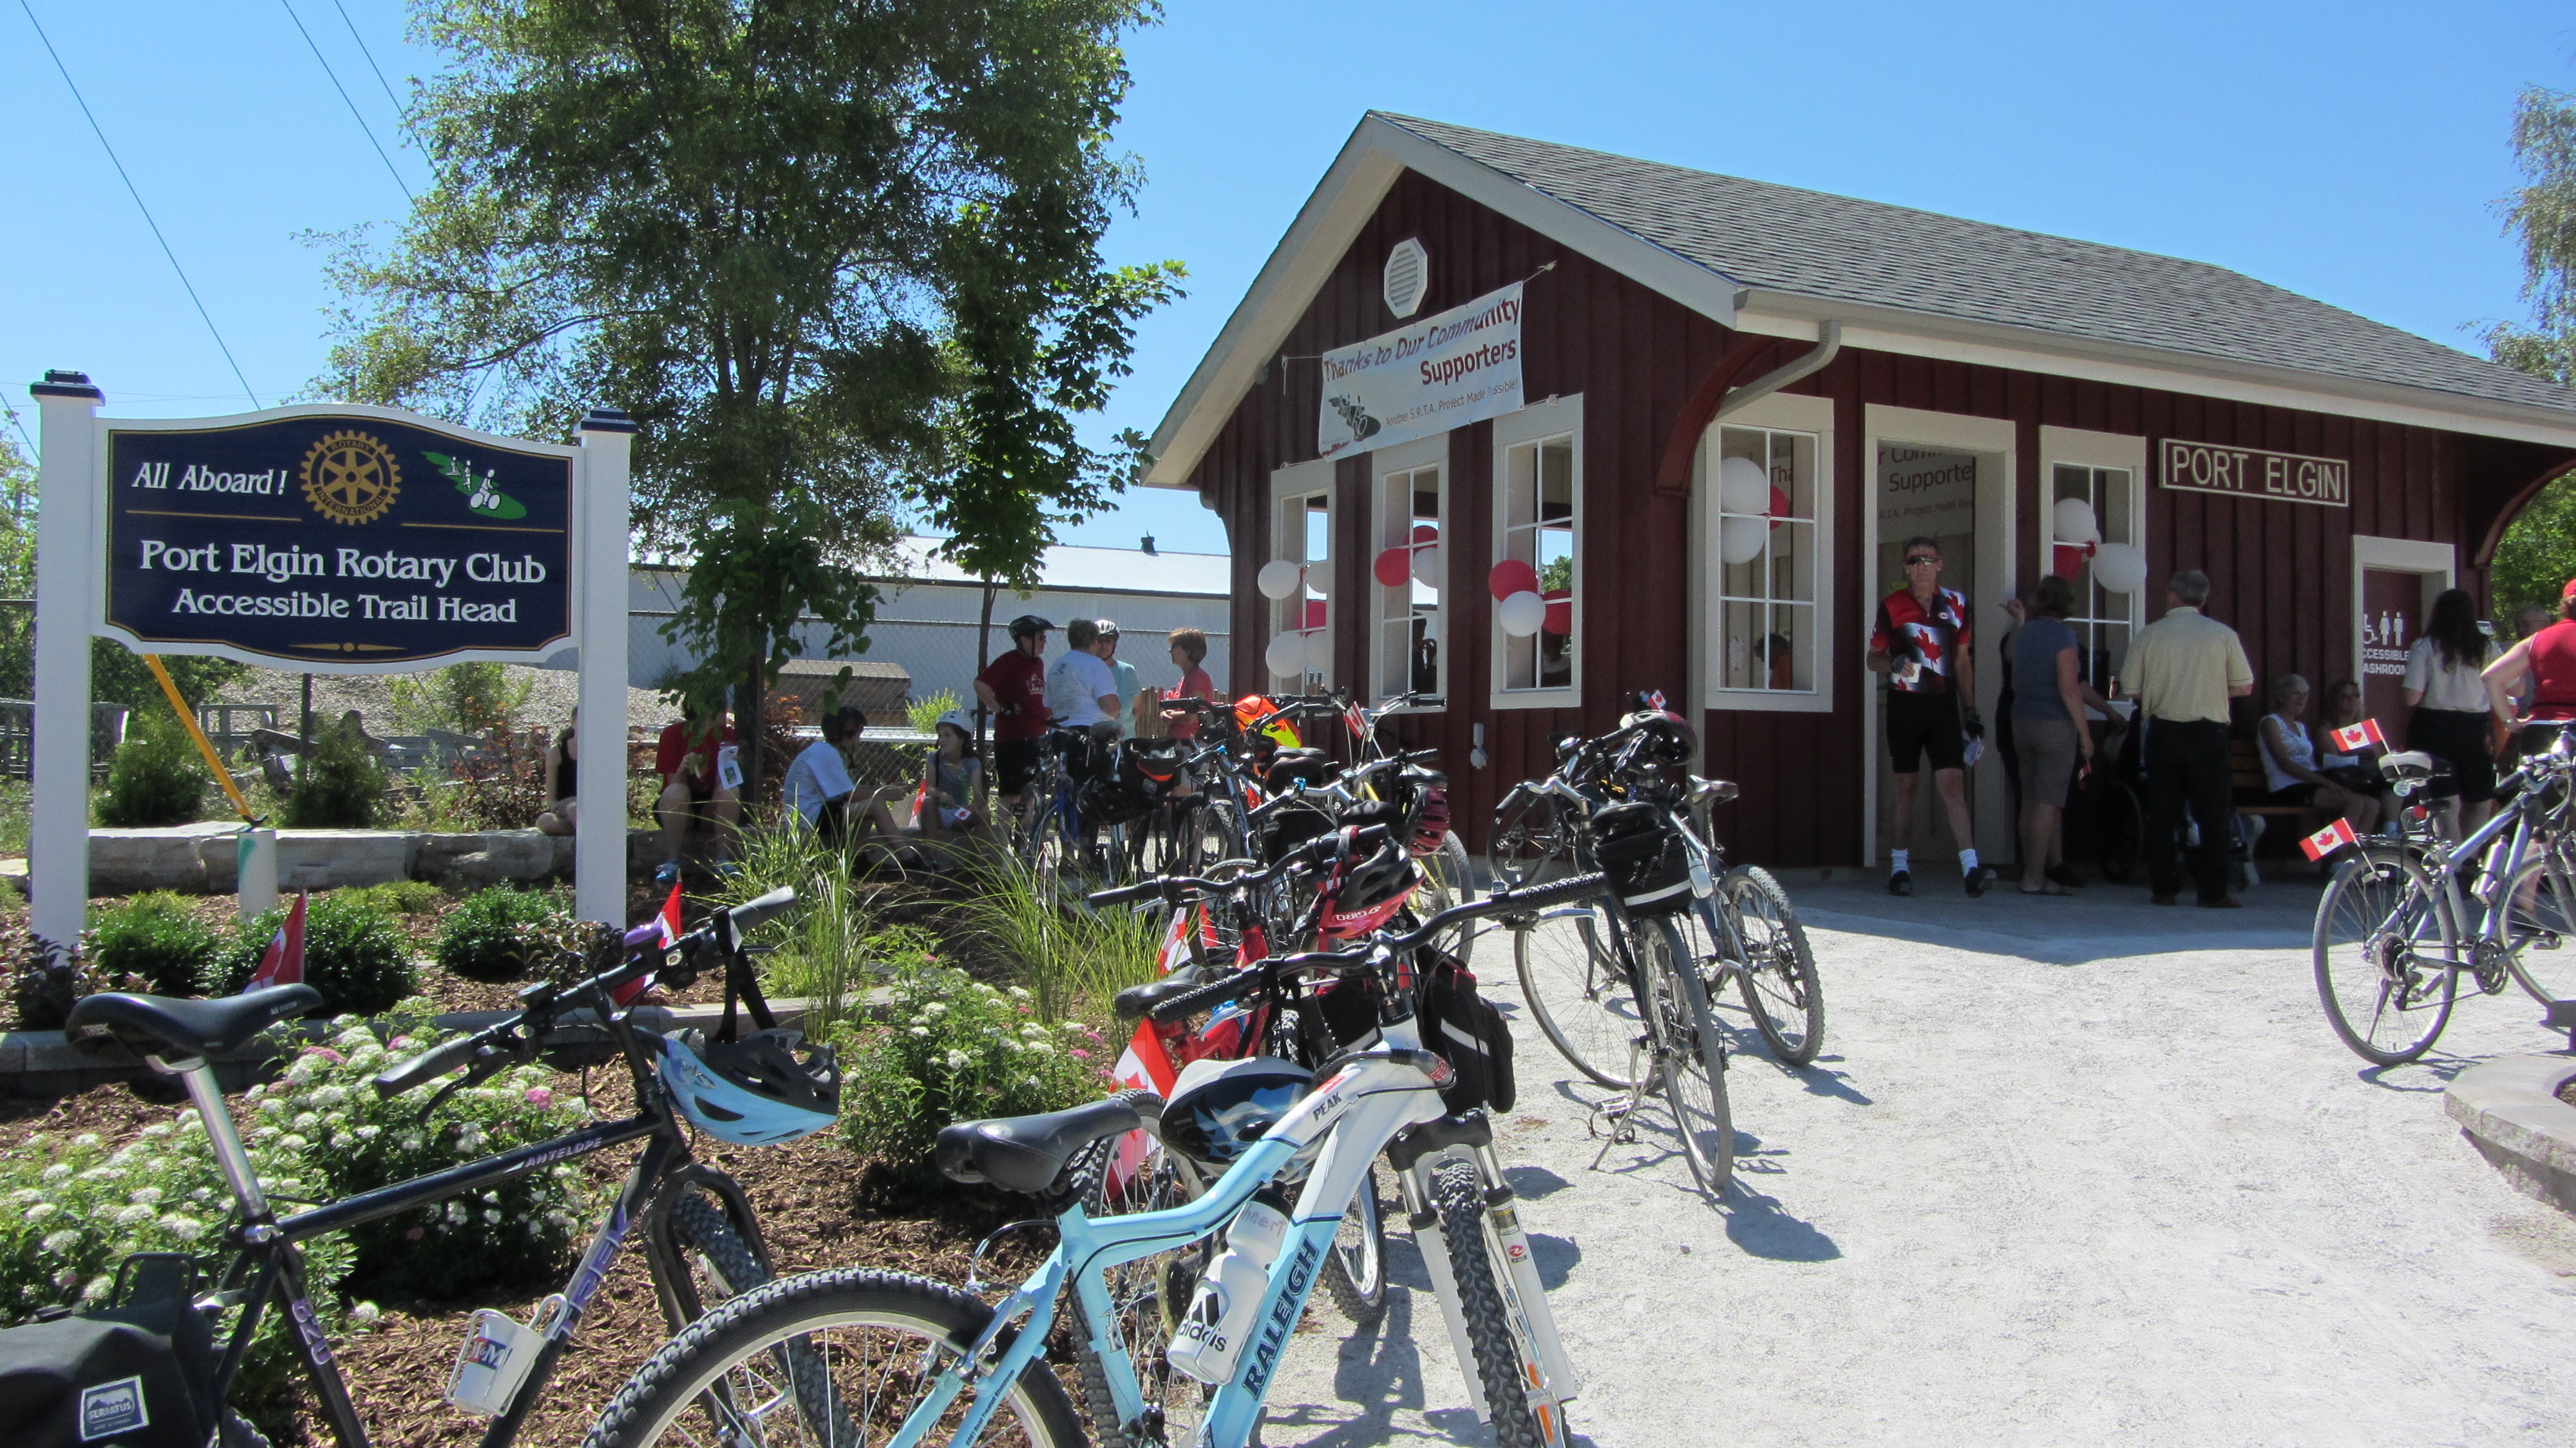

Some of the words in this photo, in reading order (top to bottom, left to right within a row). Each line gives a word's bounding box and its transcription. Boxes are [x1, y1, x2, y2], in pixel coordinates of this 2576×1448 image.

[1323, 350, 1372, 382] Thanks
[1374, 347, 1392, 366] to
[1395, 336, 1425, 360] Our
[1427, 298, 1520, 349] Community
[1420, 339, 1517, 385] Supporters
[1386, 412, 1408, 426] Another
[1439, 395, 1464, 411] Project
[1467, 388, 1486, 404] Made
[330, 440, 372, 452] ROTARY
[131, 462, 171, 489] All
[1889, 463, 1971, 493] Supporte
[2172, 446, 2249, 490] PORT
[2264, 456, 2340, 500] ELGIN
[316, 491, 386, 515] INTERNATIONAL
[1904, 504, 1932, 516] Project
[140, 540, 222, 572] Port
[231, 544, 326, 583] Elgin
[336, 548, 457, 588] Rotary
[466, 553, 546, 583] Club
[171, 588, 350, 618] Accessible
[357, 594, 429, 620] Trail
[437, 597, 517, 623] Head
[1312, 1092, 1342, 1121] PEAK
[524, 1137, 603, 1168] ANTELOPE
[551, 1203, 635, 1341] TREK
[1241, 1234, 1320, 1401] RALEIGH
